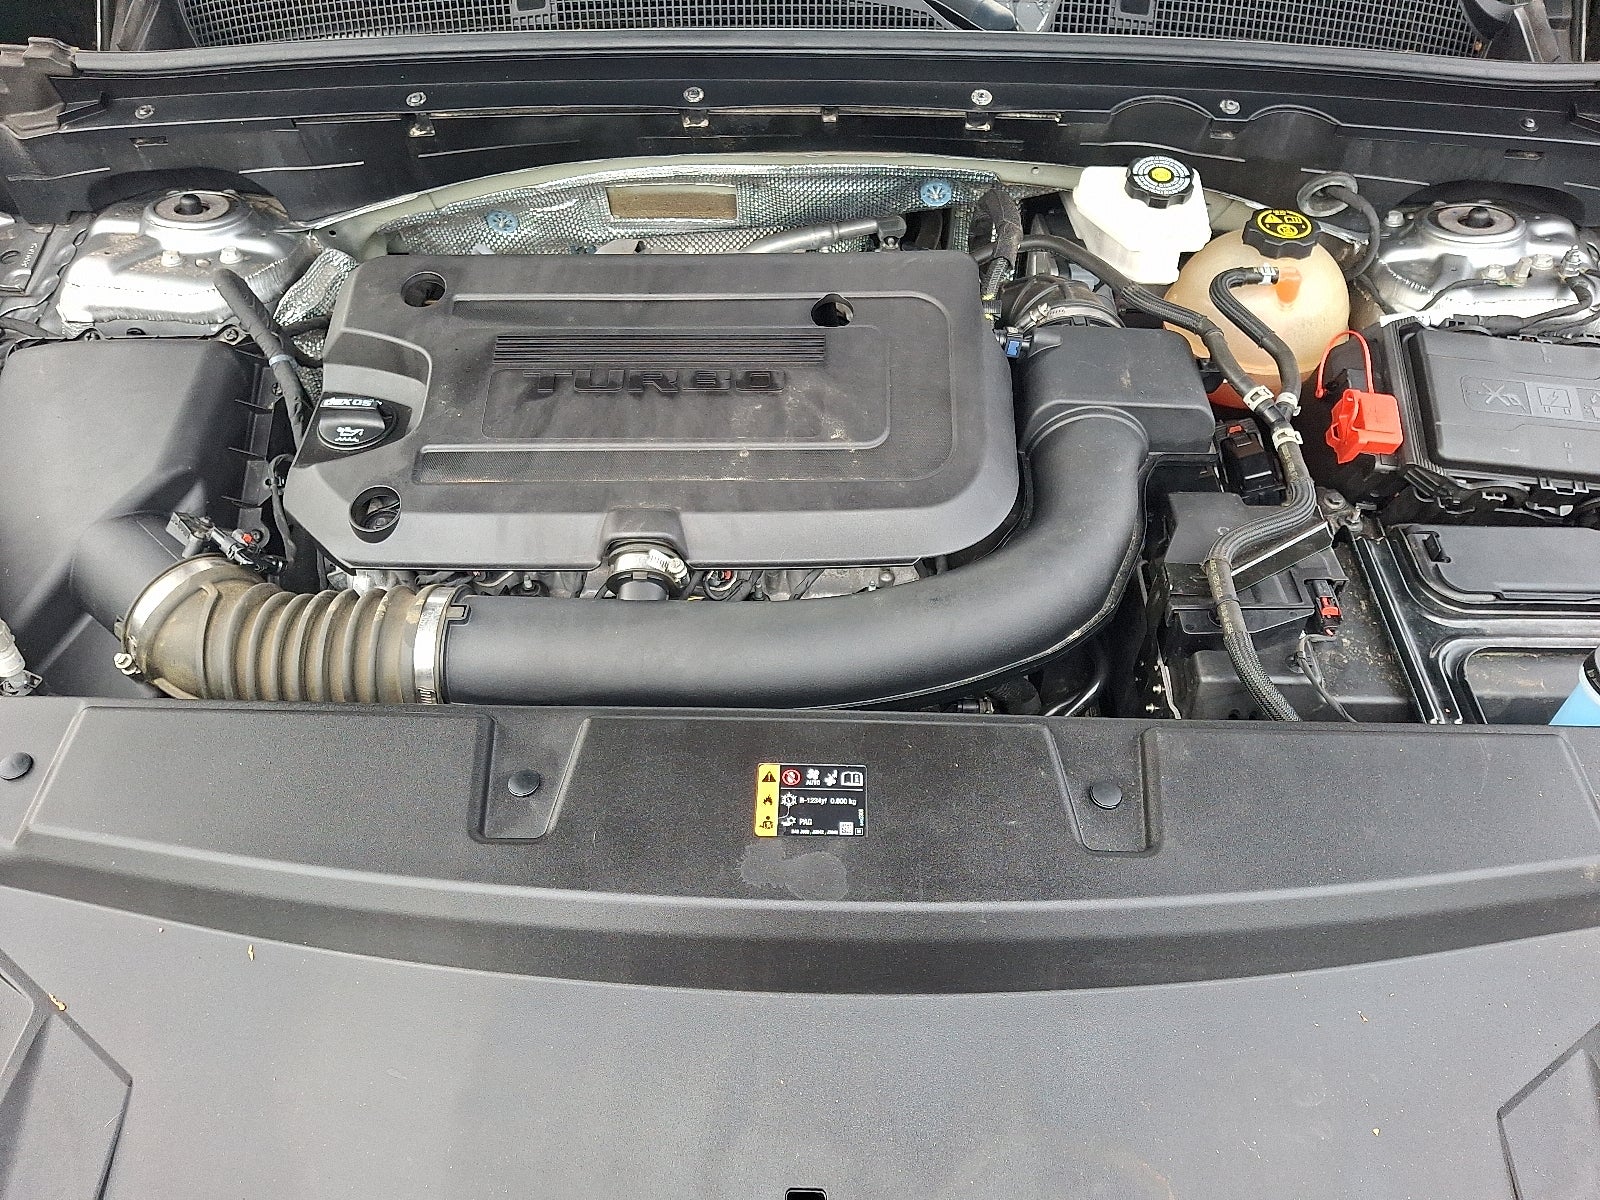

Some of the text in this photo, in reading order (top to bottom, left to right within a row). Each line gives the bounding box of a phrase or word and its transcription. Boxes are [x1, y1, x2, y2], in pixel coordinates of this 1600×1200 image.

[522, 368, 786, 393] TURBO
[848, 798, 857, 806] kg
[799, 818, 812, 826] PAG
